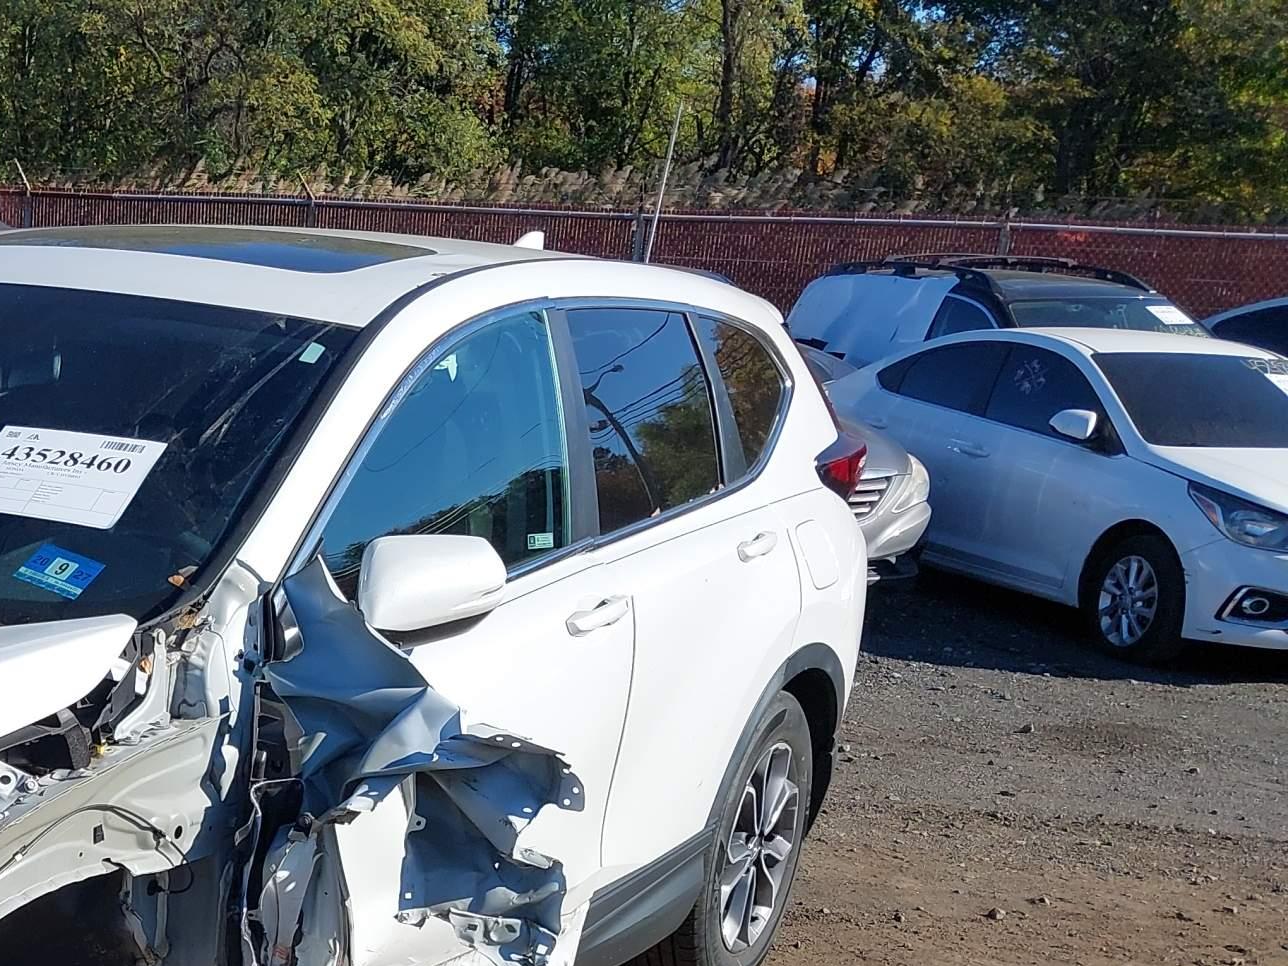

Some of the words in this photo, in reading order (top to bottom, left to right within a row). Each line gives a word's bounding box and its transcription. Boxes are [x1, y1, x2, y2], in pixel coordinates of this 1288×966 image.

[1, 445, 132, 474] 43528460
[54, 562, 70, 575] 9
[72, 569, 92, 581] 27
